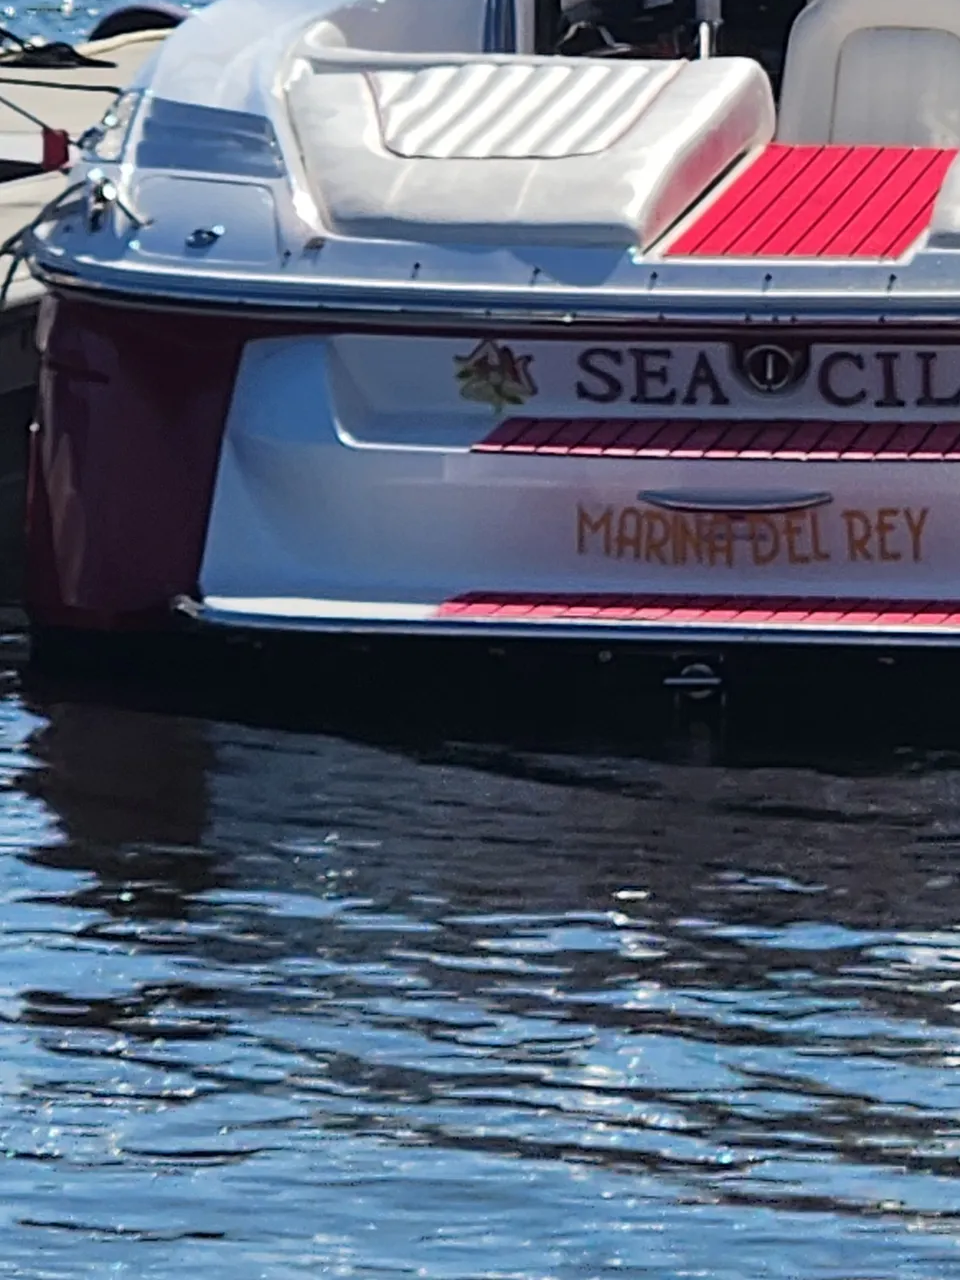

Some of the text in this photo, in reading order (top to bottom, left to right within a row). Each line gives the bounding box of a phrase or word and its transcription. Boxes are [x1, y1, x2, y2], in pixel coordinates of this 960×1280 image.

[575, 347, 730, 406] SEA
[576, 502, 930, 568] MARINA DEL REY
